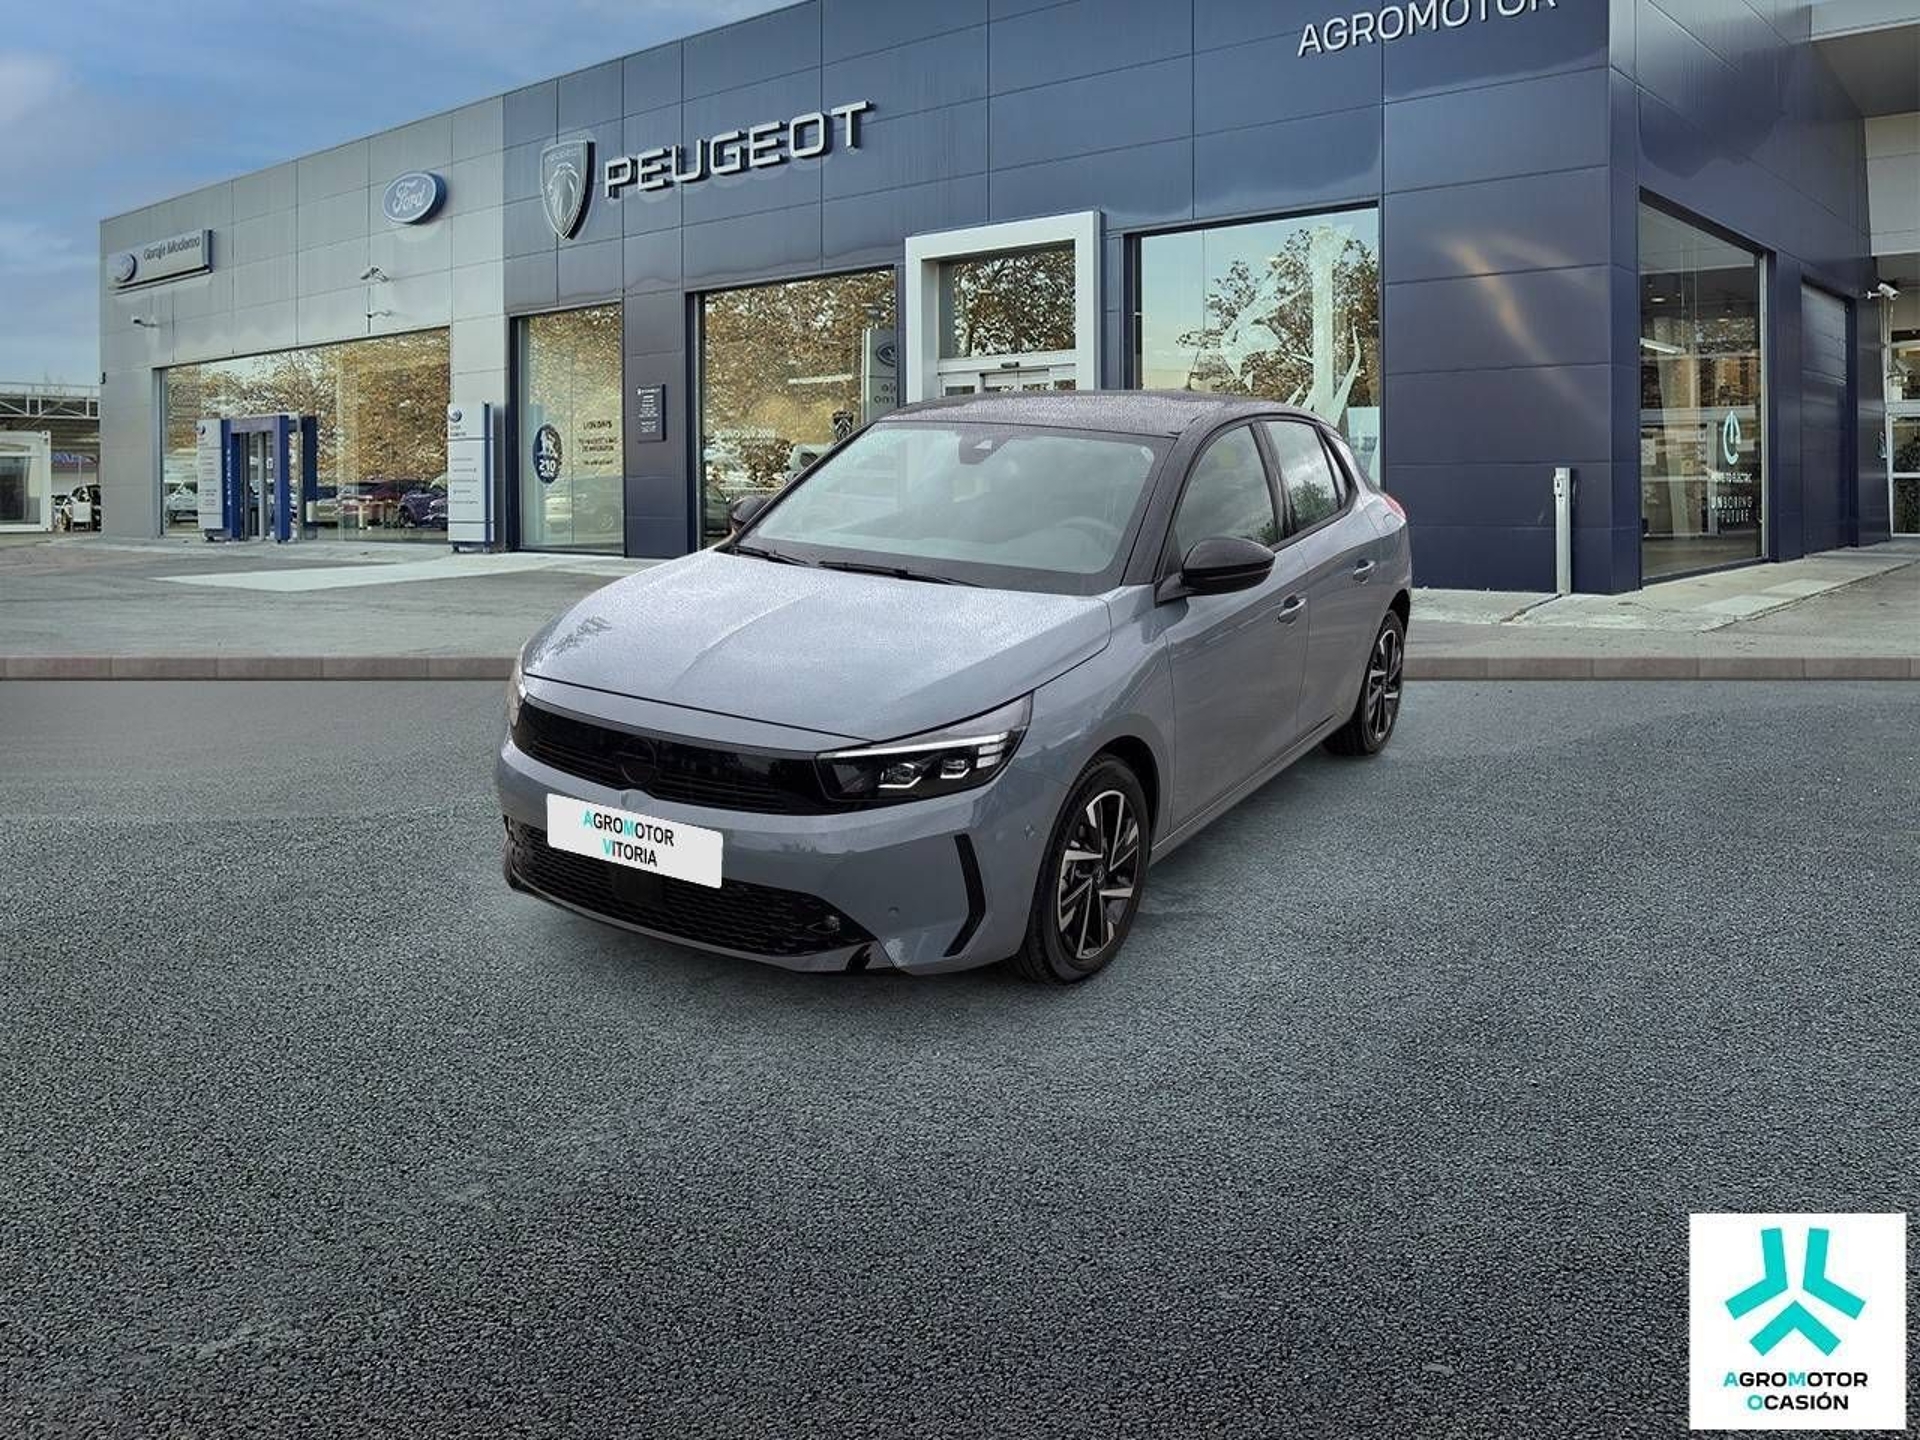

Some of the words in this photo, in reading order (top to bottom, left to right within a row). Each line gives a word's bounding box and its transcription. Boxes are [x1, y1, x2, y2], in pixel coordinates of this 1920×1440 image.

[1297, 0, 1556, 57] AGROMOTO
[604, 100, 868, 198] PEUGEOT
[392, 180, 427, 214] Ford
[539, 460, 556, 472] 210
[583, 810, 674, 847] AGROMOTOR
[603, 838, 658, 867] VITORIA
